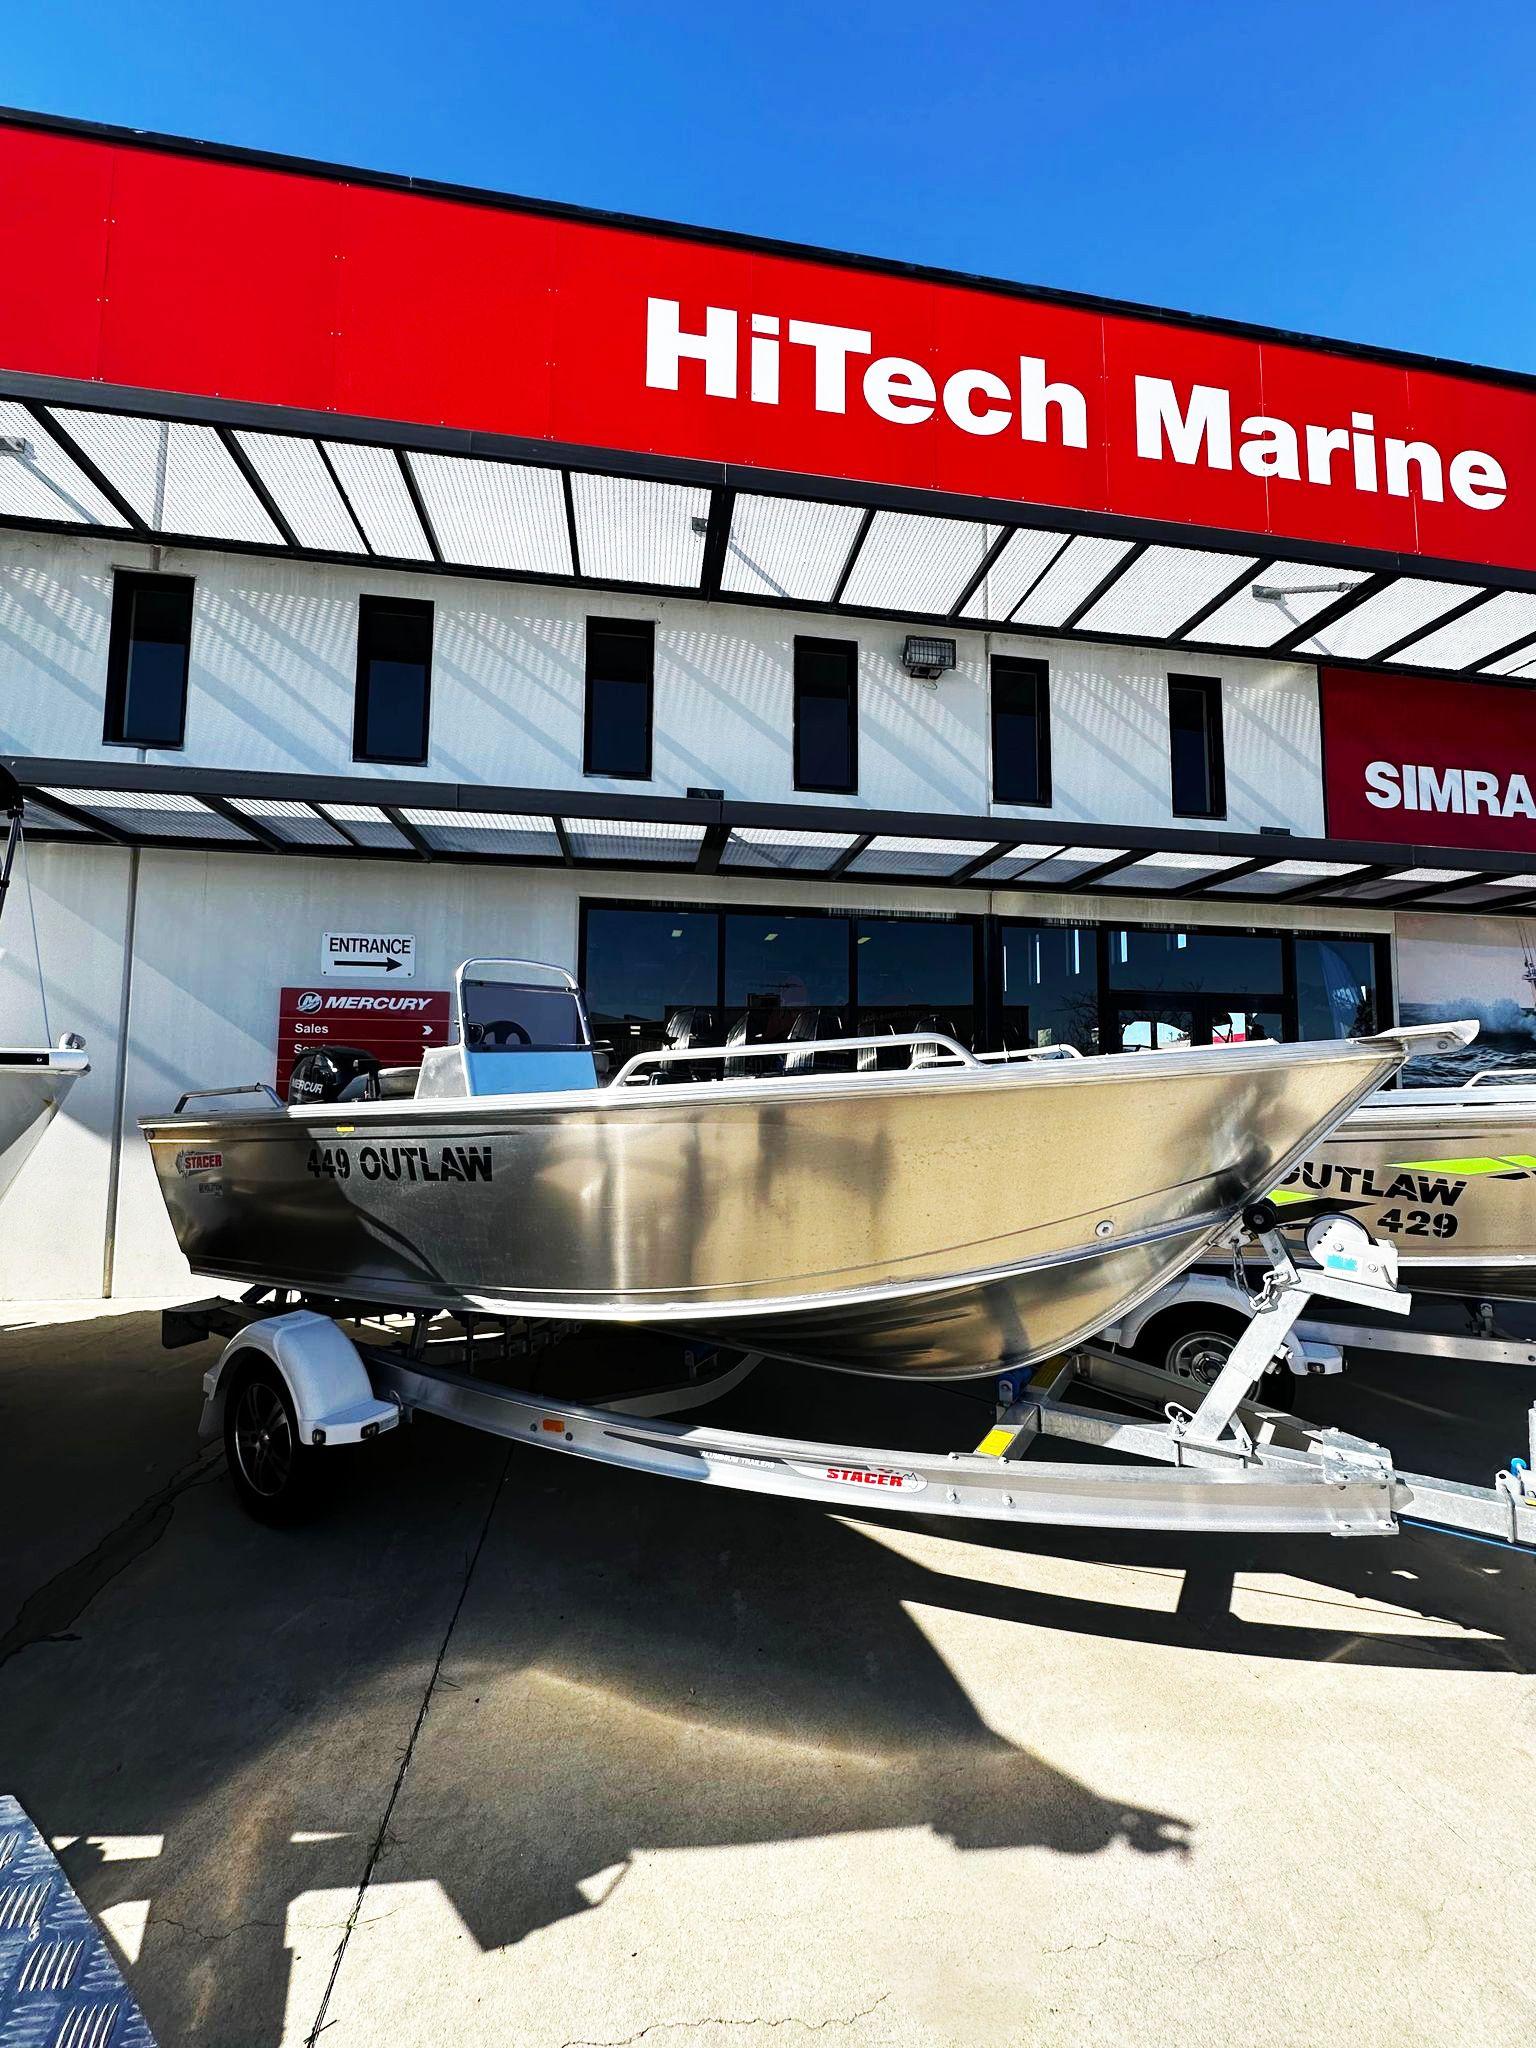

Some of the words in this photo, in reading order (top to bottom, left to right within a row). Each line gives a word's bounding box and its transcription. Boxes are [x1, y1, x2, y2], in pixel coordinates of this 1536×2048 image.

[646, 297, 1088, 449] HiTech
[1135, 374, 1508, 511] Marine
[1364, 761, 1536, 820] SIMRA
[329, 937, 412, 955] ENTRANCE
[324, 996, 433, 1011] MERCURY
[294, 1023, 329, 1034] Sales
[184, 1154, 223, 1170] STACER
[307, 1148, 350, 1180] 449
[359, 1146, 493, 1182] OUTLAW
[1376, 1208, 1459, 1239] 429
[826, 1468, 904, 1487] STACER
